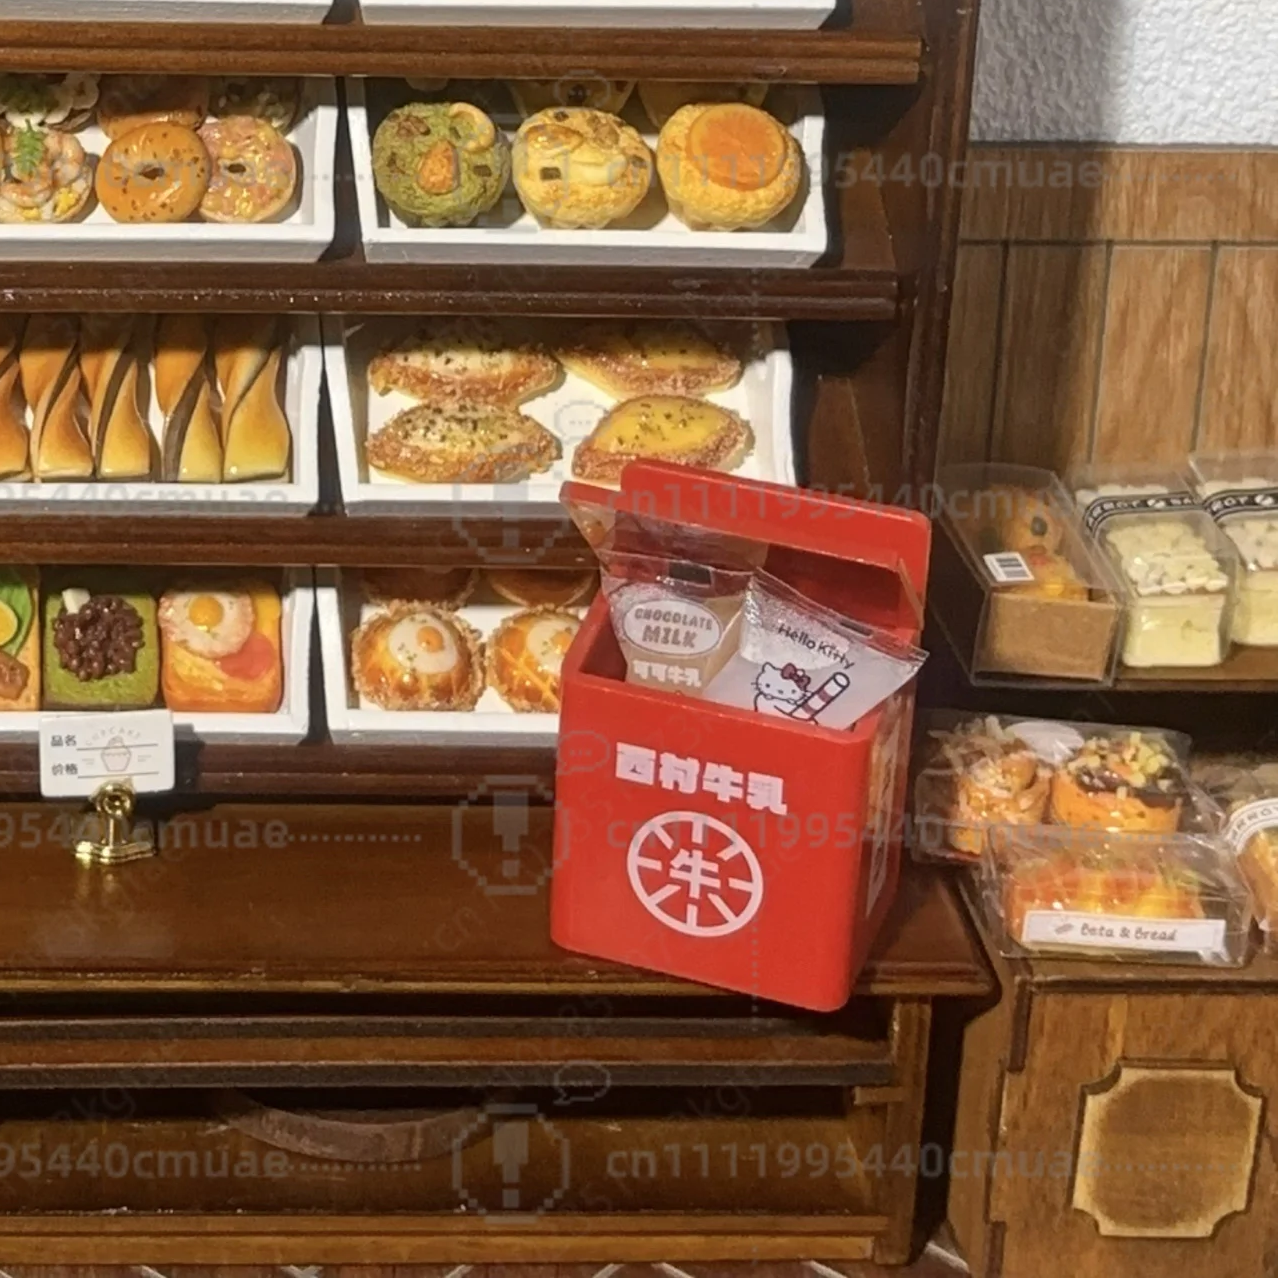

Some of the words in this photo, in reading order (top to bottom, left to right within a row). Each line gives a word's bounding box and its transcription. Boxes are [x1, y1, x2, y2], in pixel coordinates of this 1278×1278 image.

[634, 607, 713, 631] CHOCOLATE
[641, 624, 698, 649] MILK
[777, 623, 817, 650] Hello
[817, 640, 856, 670] Kitty
[50, 734, 77, 747] 品名
[51, 763, 78, 776] 价格
[615, 741, 787, 816] 西村牛乳
[669, 849, 721, 899] 牛
[1119, 924, 1131, 938] &
[1134, 923, 1178, 942] Bread
